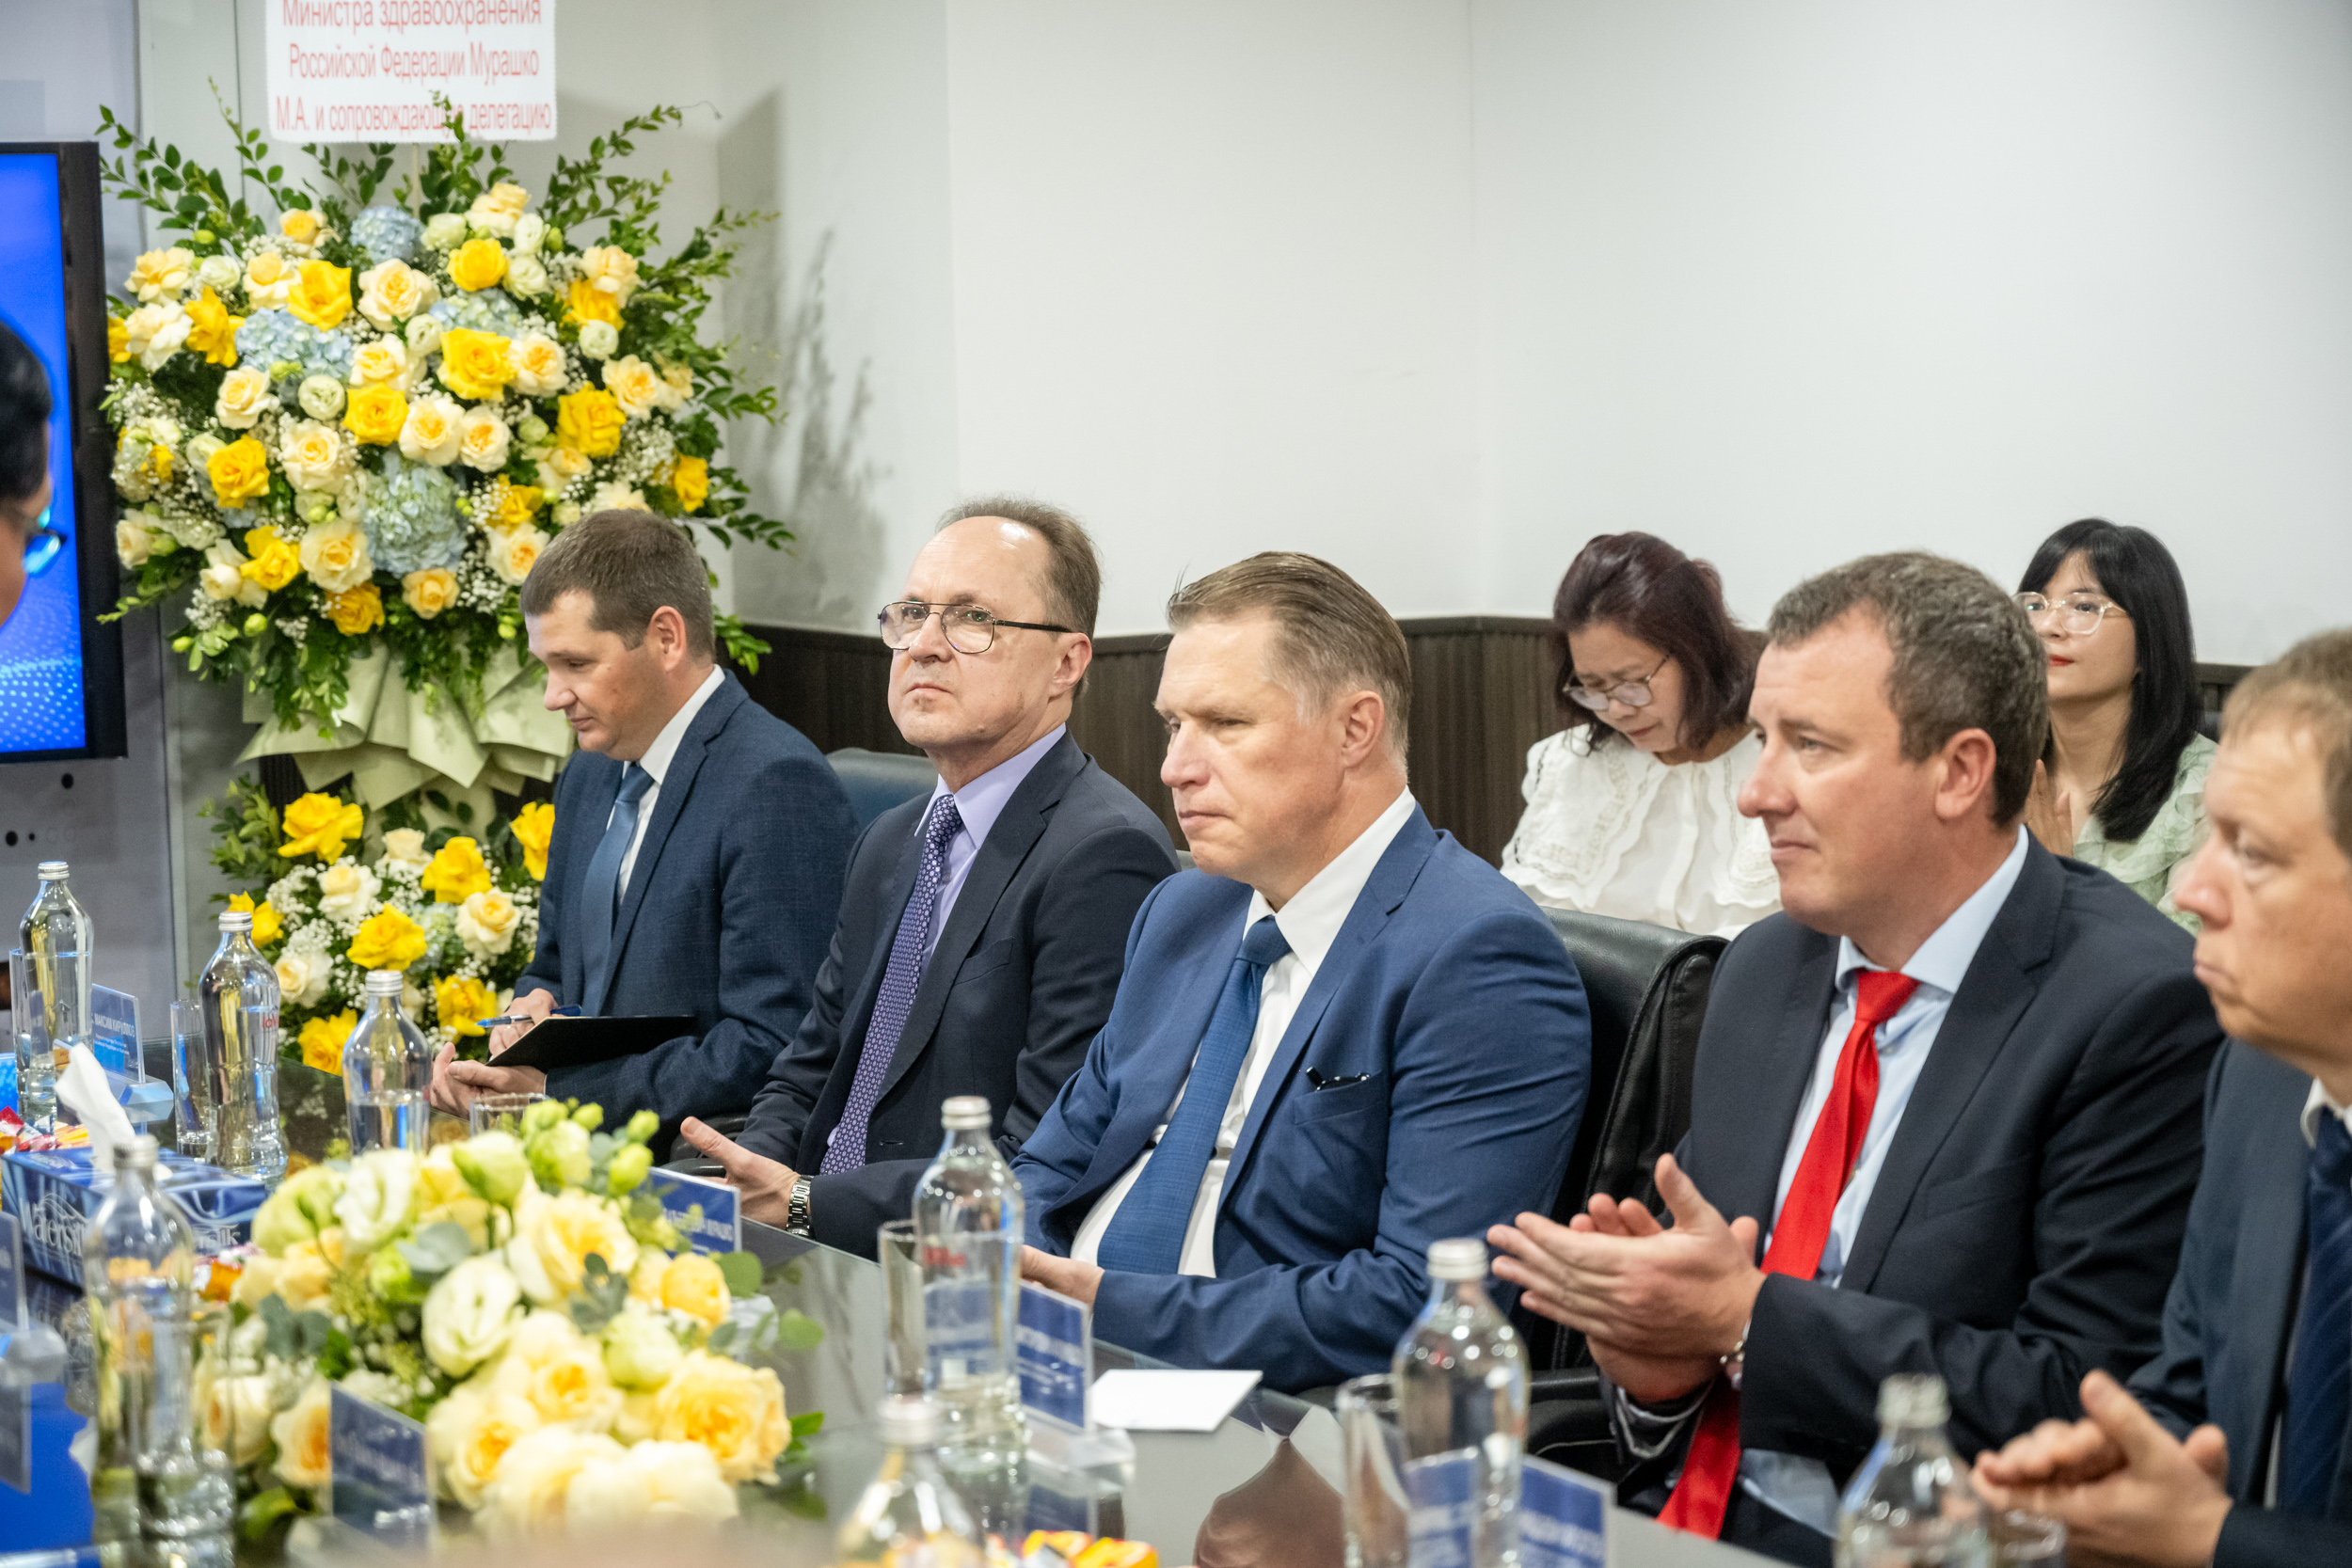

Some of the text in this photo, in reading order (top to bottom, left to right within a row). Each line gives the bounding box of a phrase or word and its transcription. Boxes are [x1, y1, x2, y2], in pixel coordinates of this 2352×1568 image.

[282, 0, 542, 35] Министра здравоохранения
[289, 41, 539, 86] Российской Федерации Мурашко
[276, 96, 310, 131] М.А.
[315, 105, 325, 130] и
[469, 103, 551, 135] делегацию
